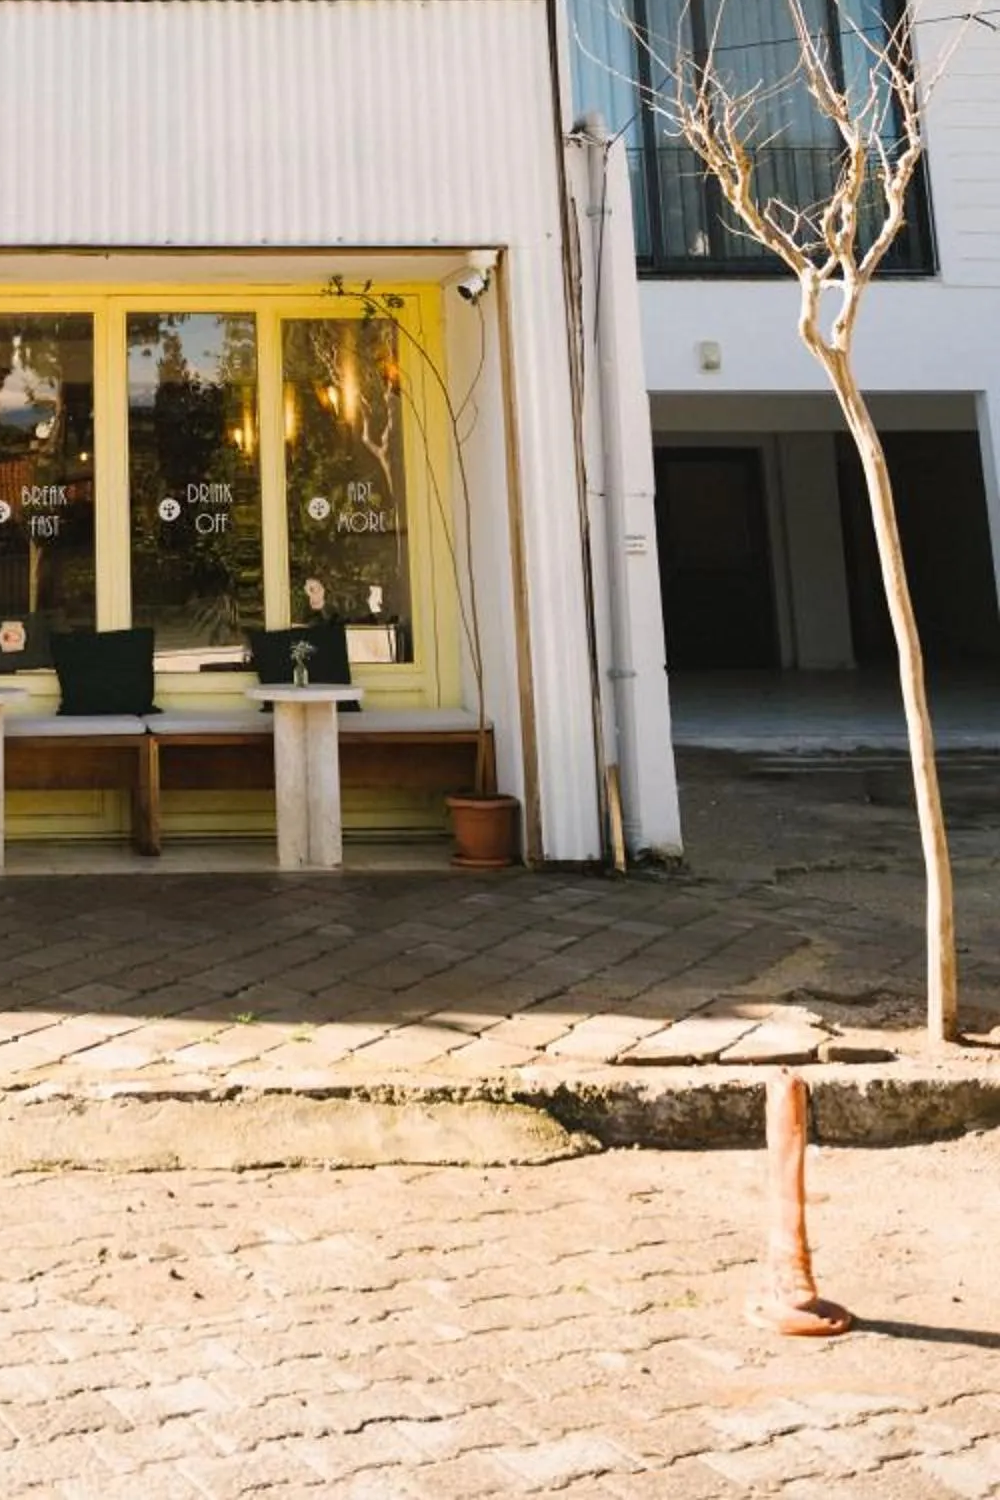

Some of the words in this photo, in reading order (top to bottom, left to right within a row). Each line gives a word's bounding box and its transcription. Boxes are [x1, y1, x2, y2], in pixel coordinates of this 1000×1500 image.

[21, 484, 68, 507] BREAK
[187, 483, 233, 503] DRINK
[28, 515, 60, 537] FAST
[195, 513, 228, 534] OFF
[337, 510, 387, 533] MORE
